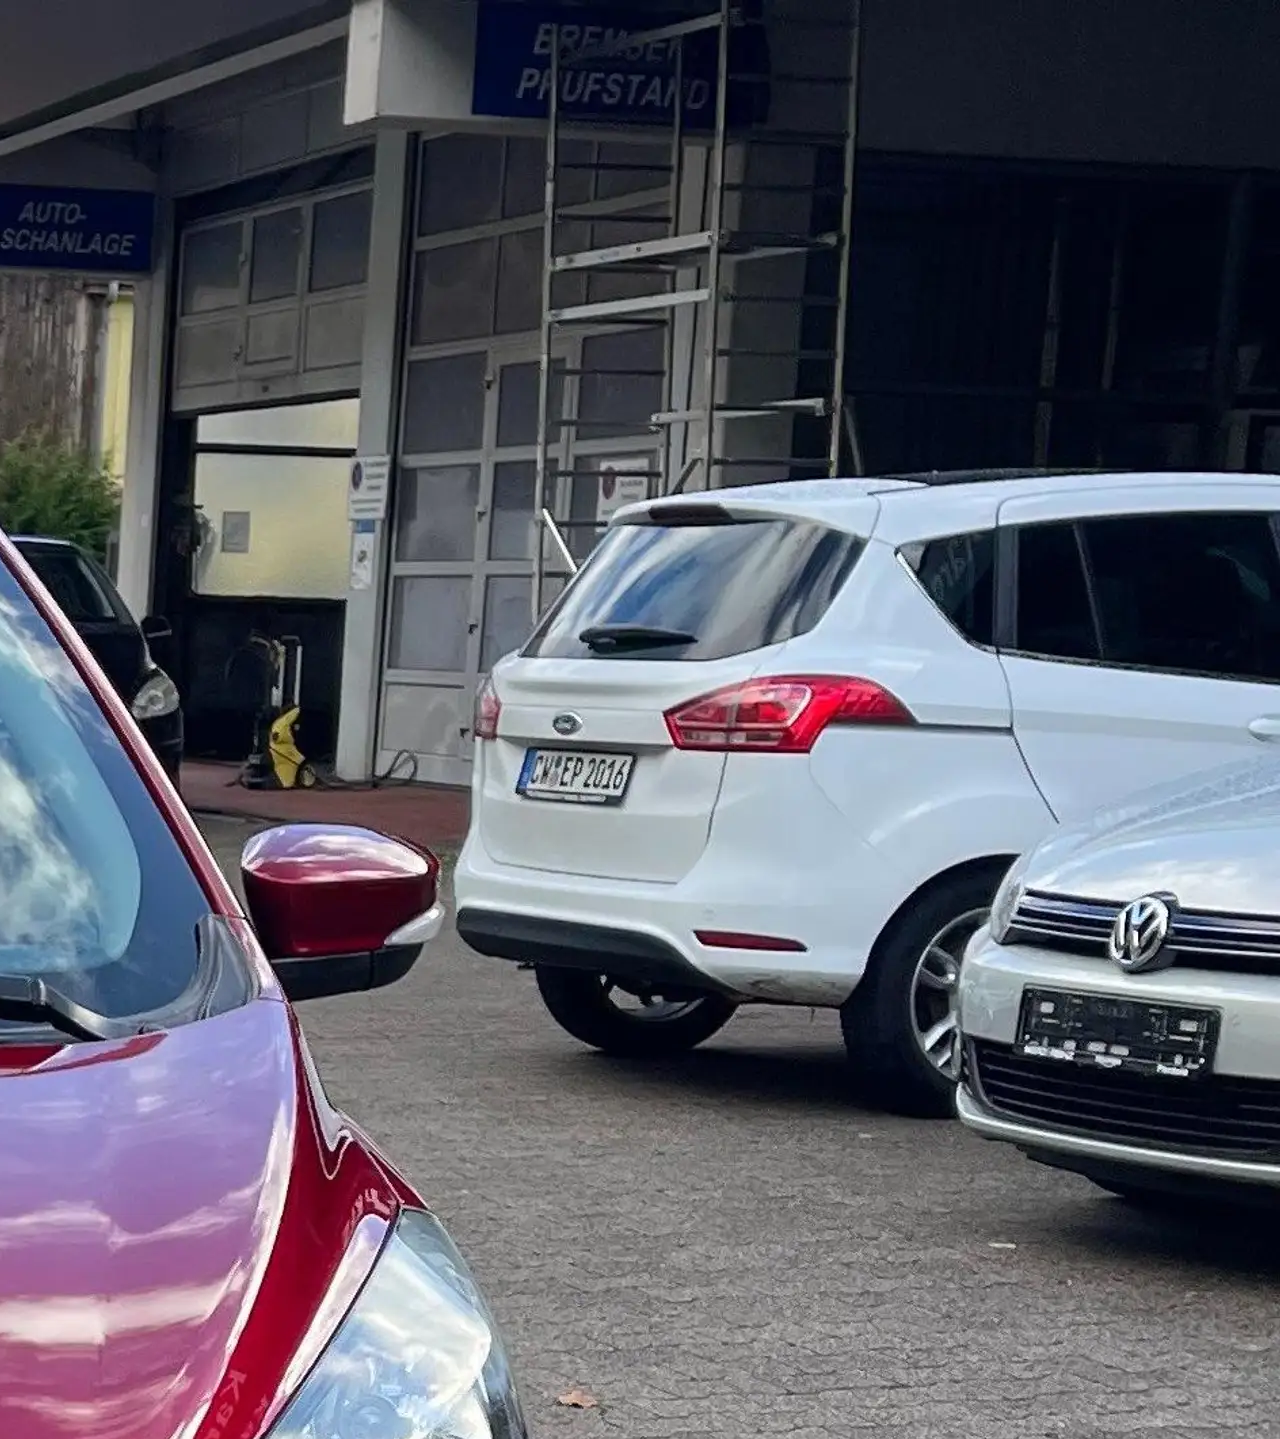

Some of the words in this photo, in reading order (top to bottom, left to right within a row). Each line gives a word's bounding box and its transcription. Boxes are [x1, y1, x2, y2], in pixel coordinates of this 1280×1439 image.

[18, 201, 87, 224] AUTO-
[530, 754, 556, 785] CW
[558, 756, 584, 788] EP
[583, 756, 628, 790] 2016
